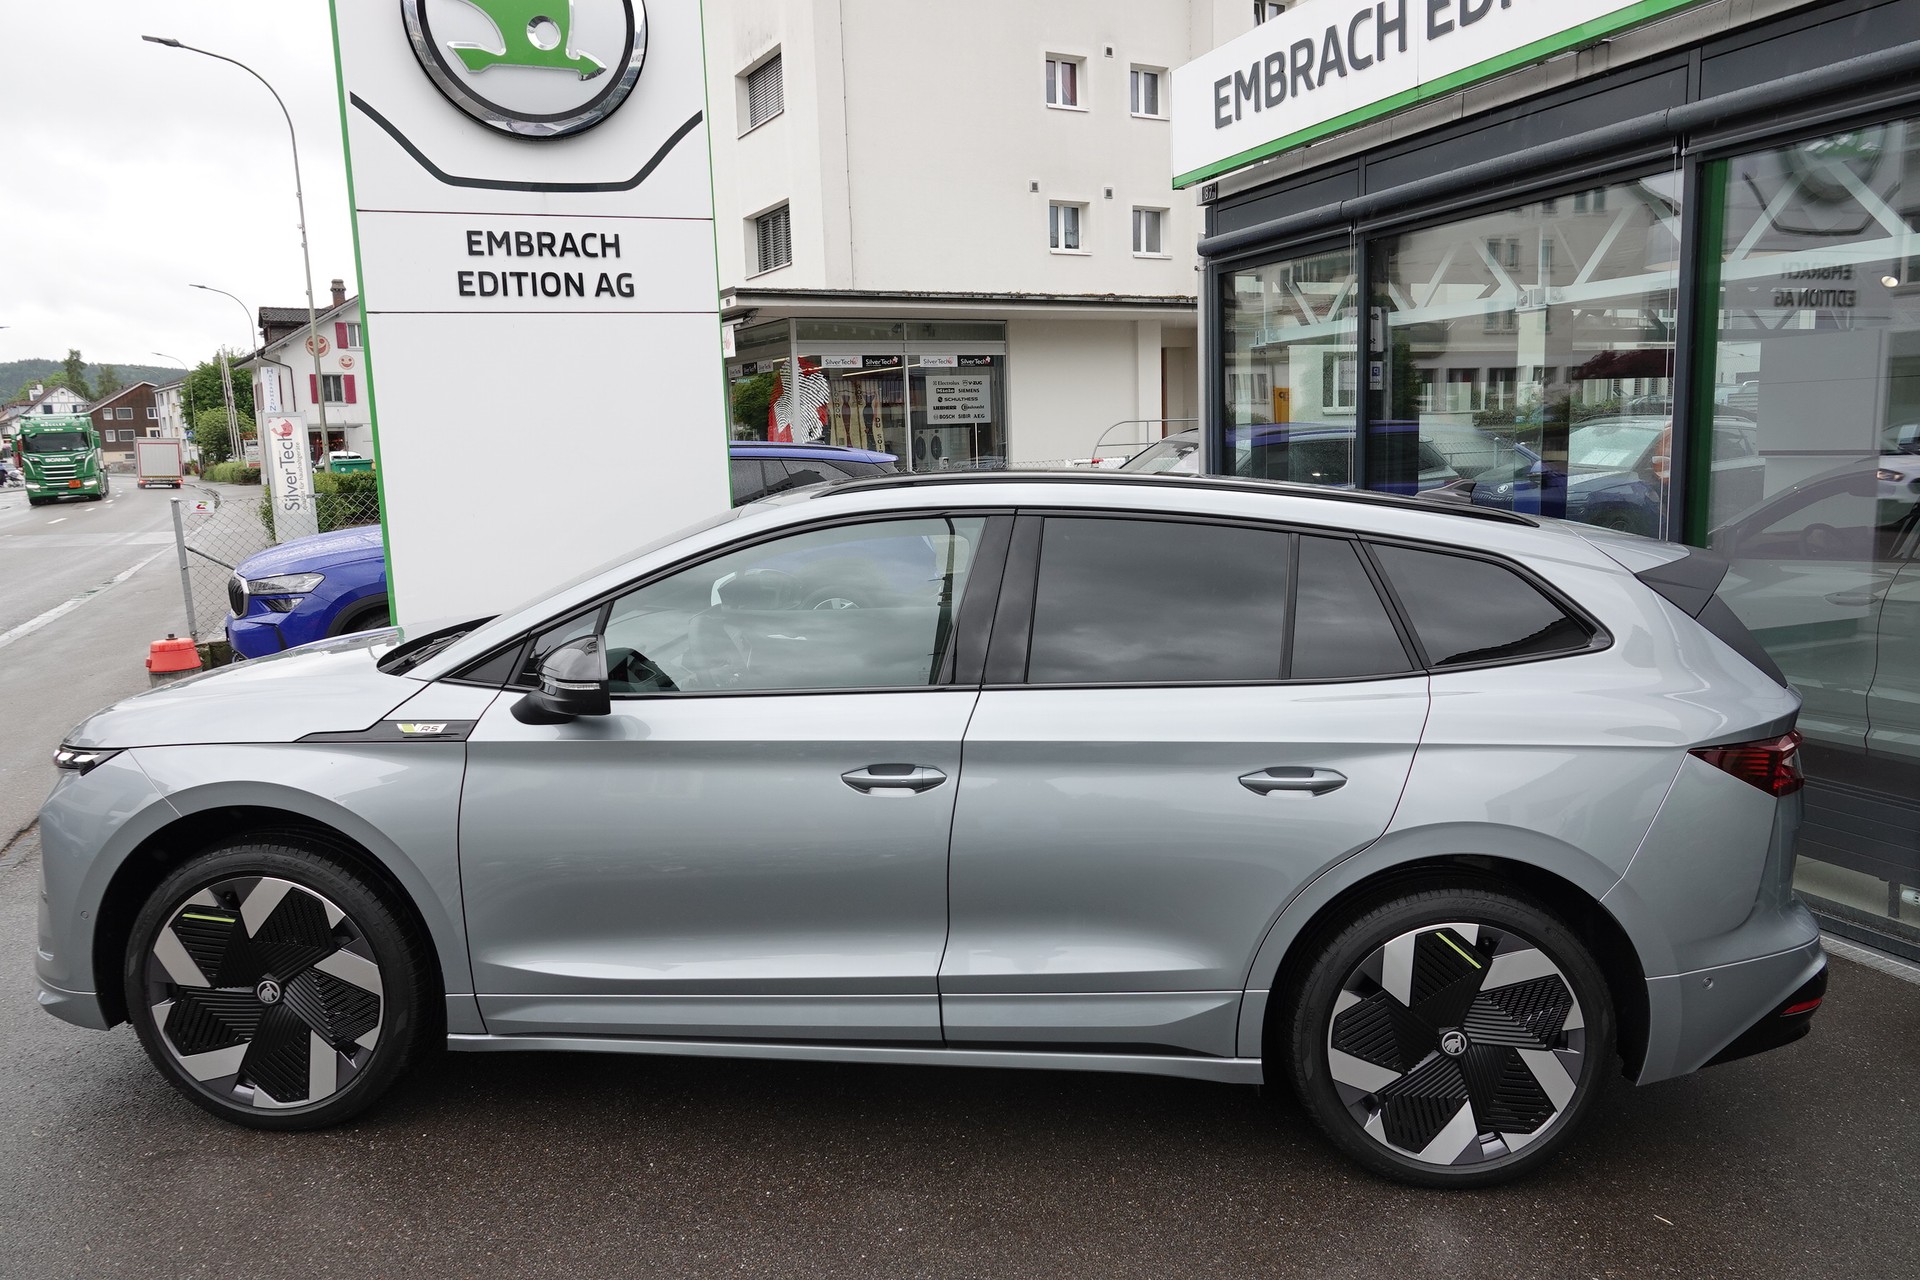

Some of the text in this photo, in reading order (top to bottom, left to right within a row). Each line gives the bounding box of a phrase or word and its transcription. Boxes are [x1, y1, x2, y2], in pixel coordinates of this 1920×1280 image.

[1213, 0, 1408, 129] EMBRACH
[466, 230, 621, 258] EMBRACH
[457, 270, 635, 298] EDITION AG
